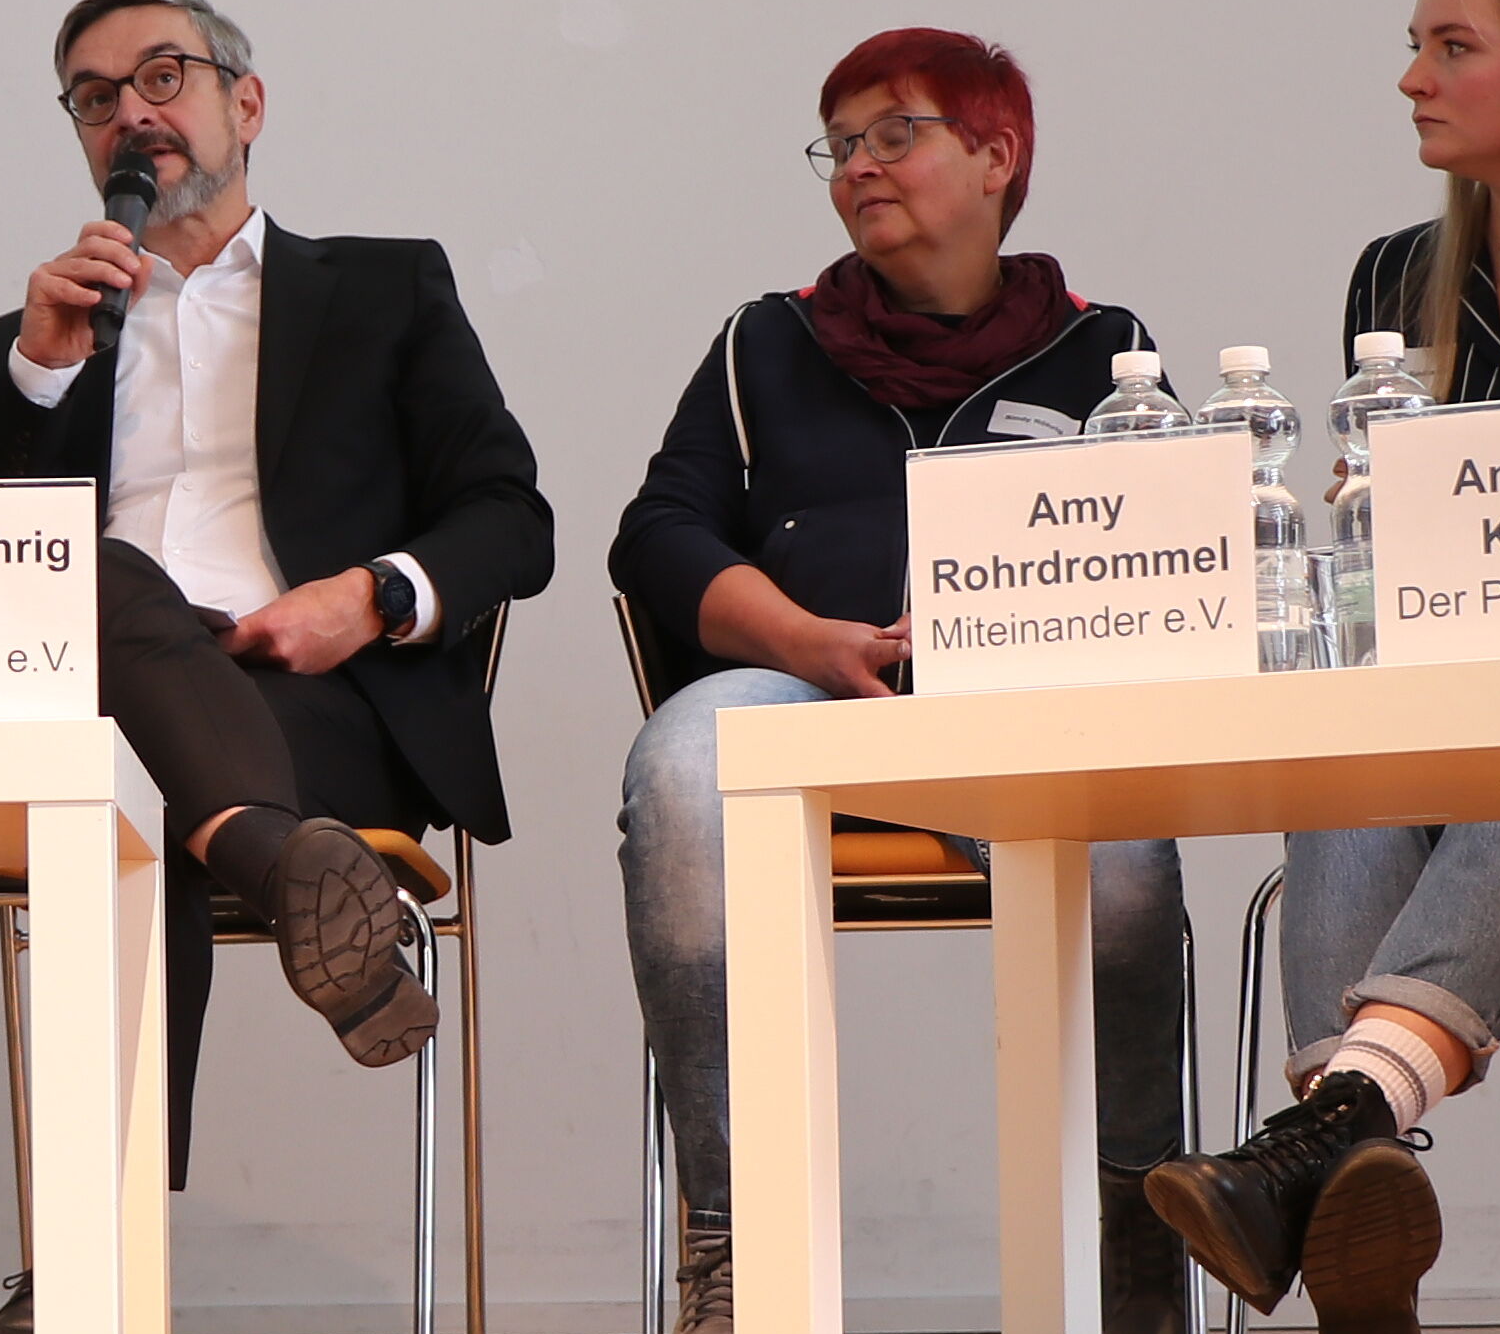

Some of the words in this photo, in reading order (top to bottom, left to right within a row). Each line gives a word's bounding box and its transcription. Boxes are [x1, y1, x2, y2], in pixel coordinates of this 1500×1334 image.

[1028, 493, 1124, 531] Amy
[933, 536, 1228, 593] Rohrdrommel
[1398, 586, 1467, 620] Der
[932, 606, 1150, 650] Miteinander
[1164, 597, 1232, 633] e.V.
[7, 641, 73, 673] e.V.
